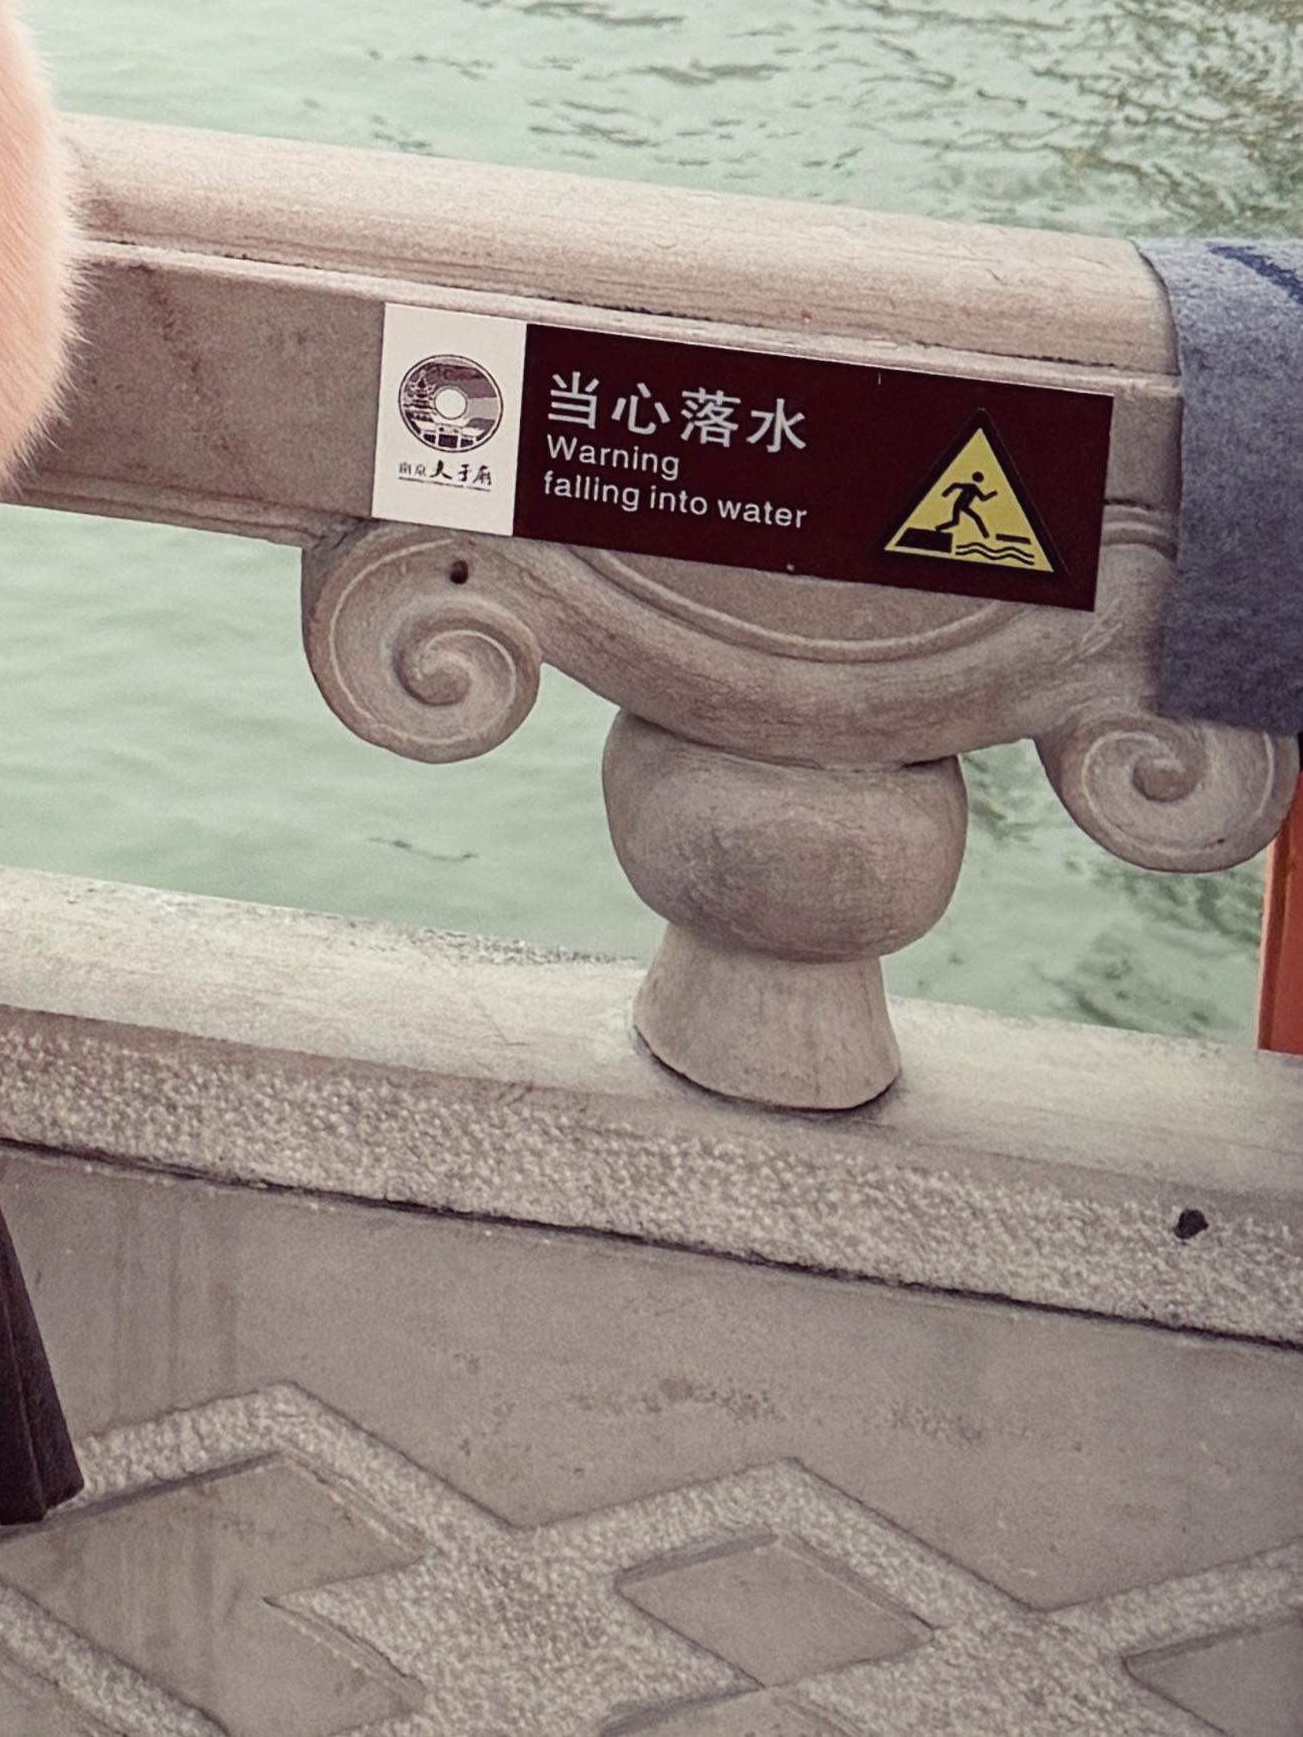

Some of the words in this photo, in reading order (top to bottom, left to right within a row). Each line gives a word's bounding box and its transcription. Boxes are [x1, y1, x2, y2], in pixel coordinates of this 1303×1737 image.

[547, 371, 807, 453] 当心落水
[546, 434, 680, 481] Warning
[544, 470, 641, 513] falling
[649, 485, 709, 516] into
[716, 499, 808, 529] water
